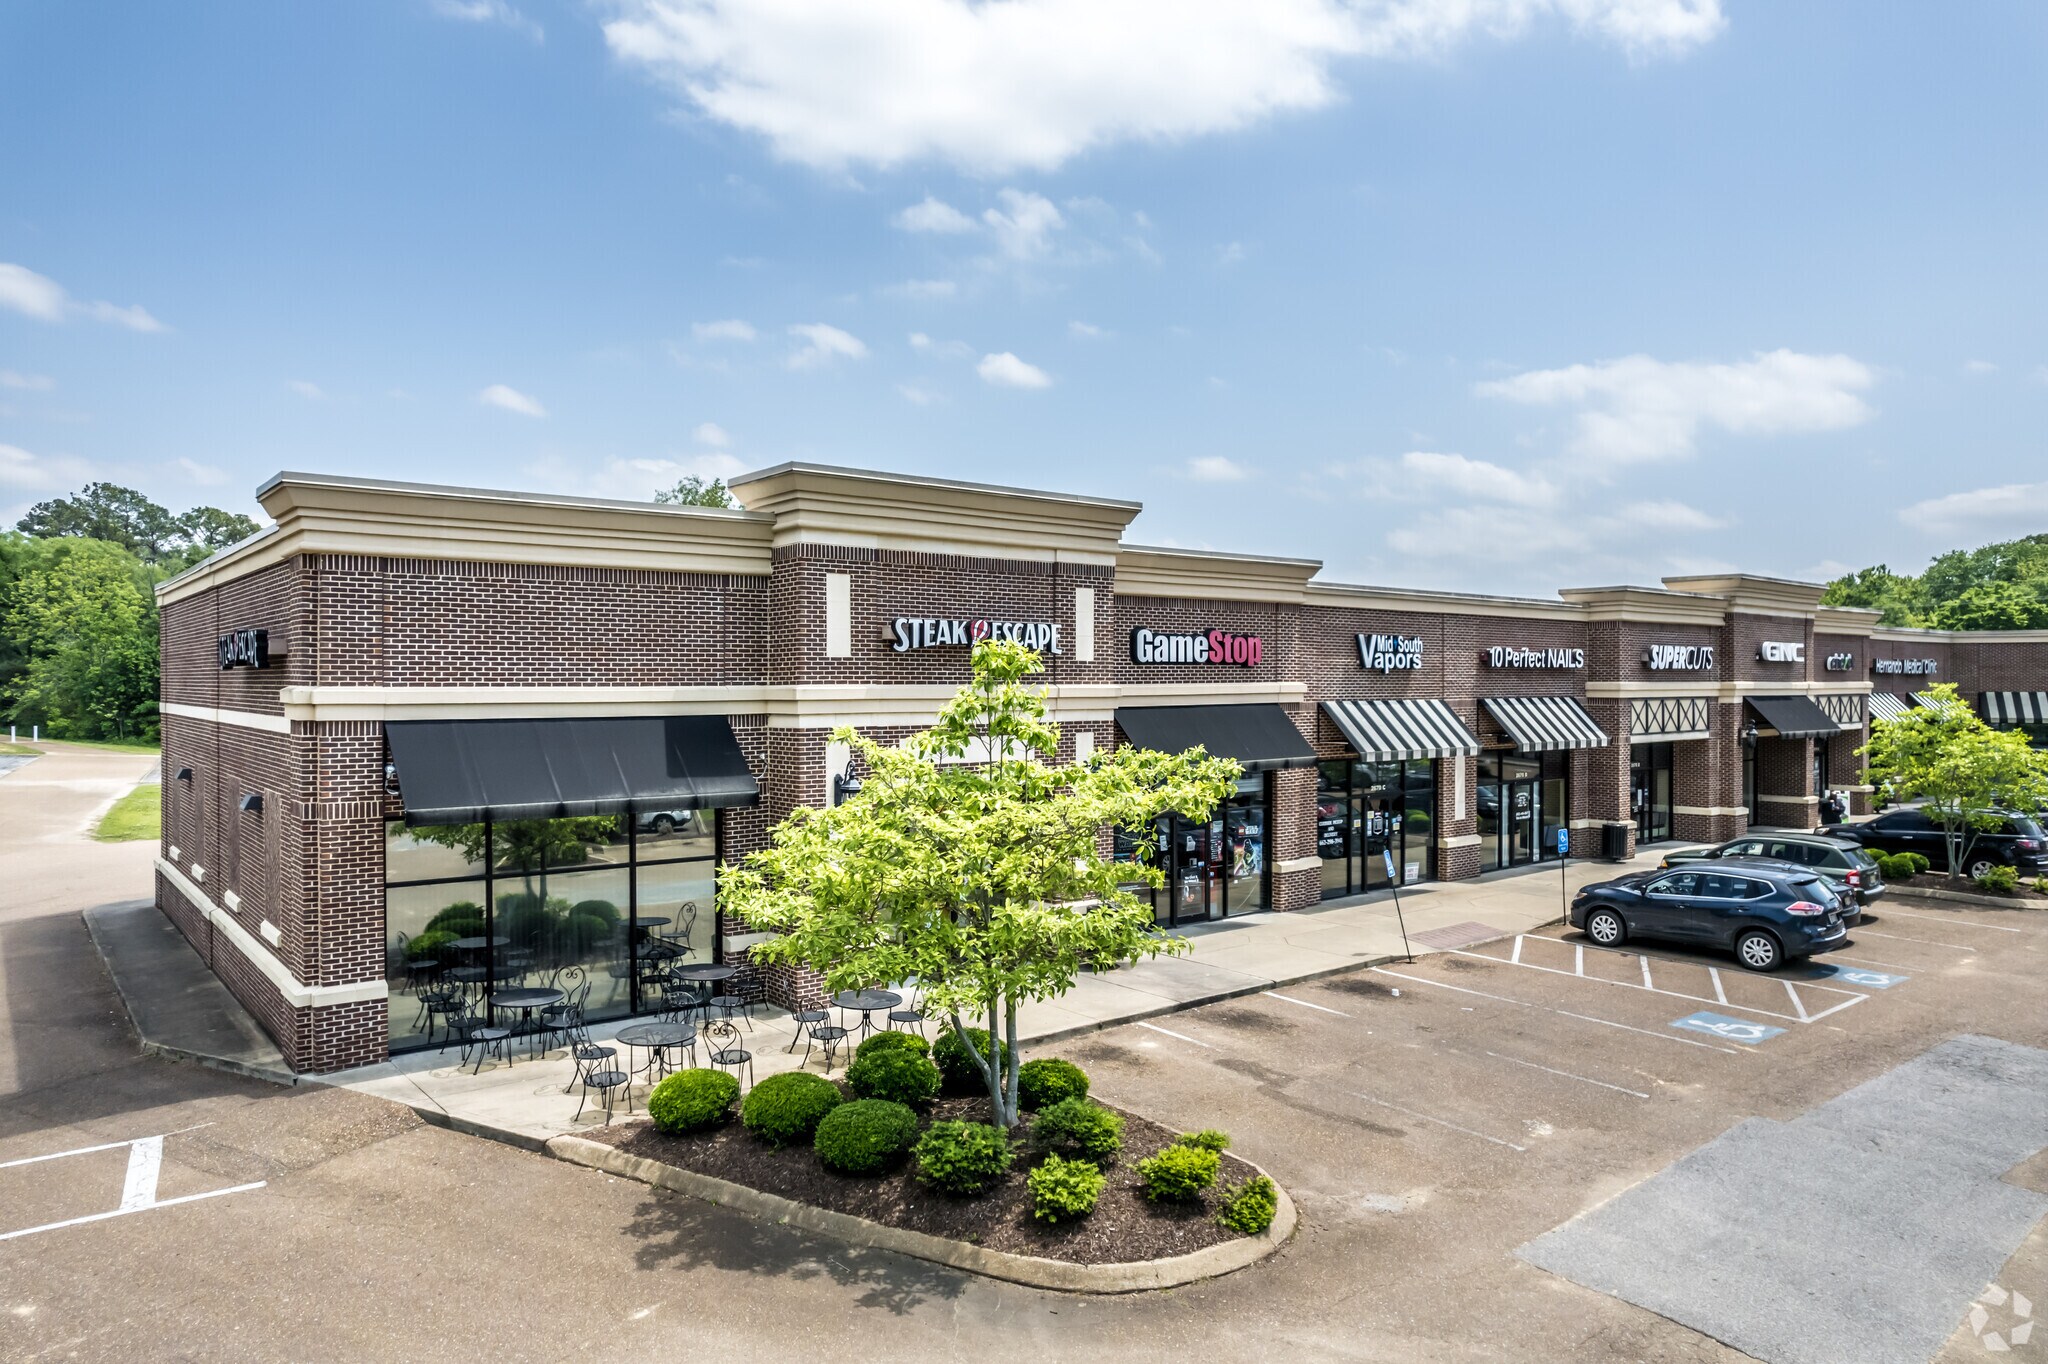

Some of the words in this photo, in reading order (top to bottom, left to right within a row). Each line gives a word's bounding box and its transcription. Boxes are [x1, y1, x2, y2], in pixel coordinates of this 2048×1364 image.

[892, 617, 968, 652] STEAK
[991, 621, 1063, 655] ESCAPE
[1136, 628, 1263, 667] GameStop
[1377, 634, 1394, 652] Mid
[1397, 635, 1424, 653] South
[1358, 633, 1423, 674] Vapors
[1489, 646, 1503, 668] 10
[1505, 647, 1546, 668] Perfect
[1547, 648, 1584, 669] NAILS
[1650, 644, 1714, 670] SUPERCUTS
[1763, 641, 1805, 662] GNC
[1875, 657, 1903, 674] Hernando
[1903, 657, 1924, 675] Medical
